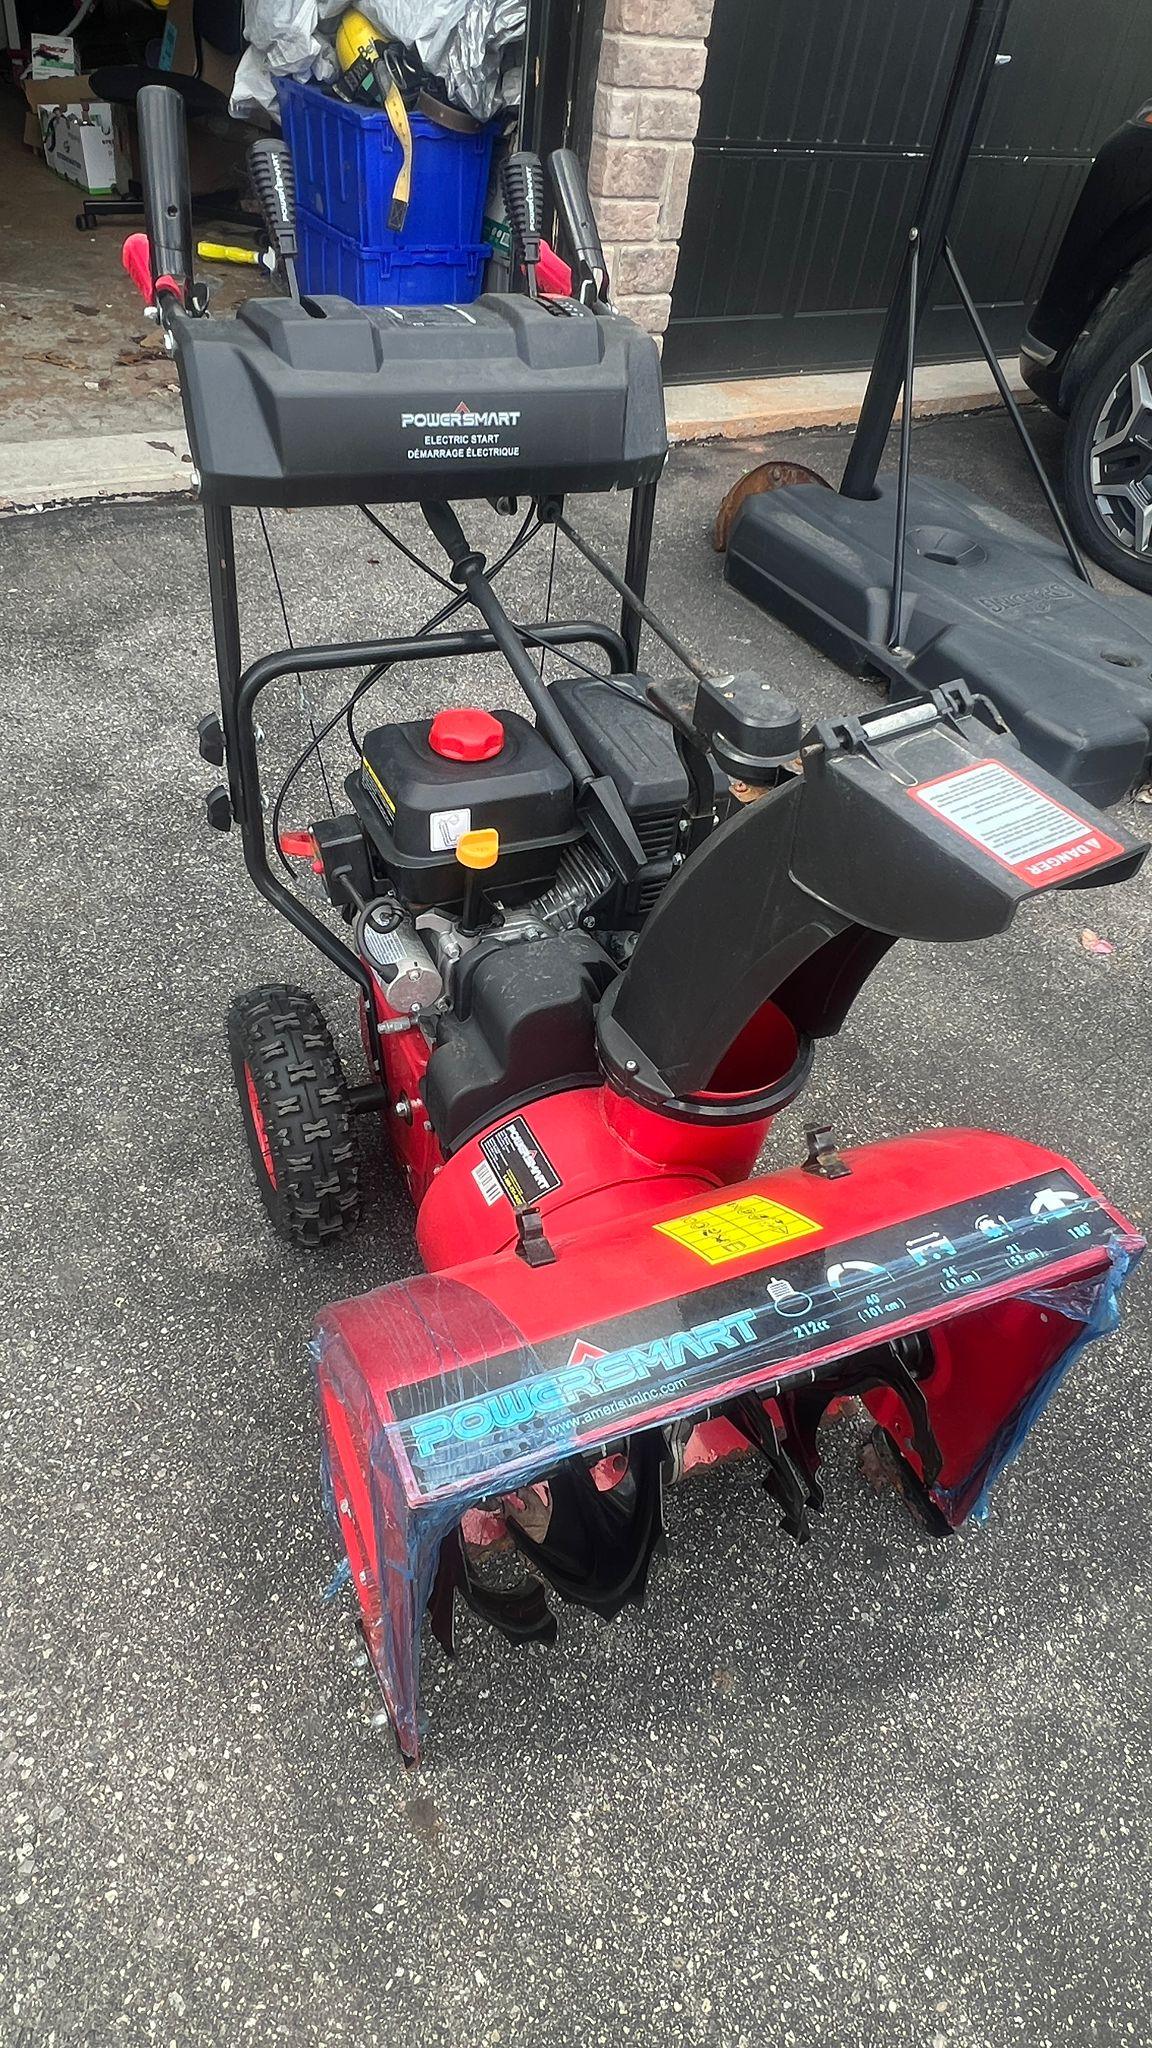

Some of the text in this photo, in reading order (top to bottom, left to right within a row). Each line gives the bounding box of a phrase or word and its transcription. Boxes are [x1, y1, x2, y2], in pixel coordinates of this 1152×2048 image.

[401, 412, 521, 428] POWERSMART
[424, 434, 500, 445] ELECTRIC START
[407, 447, 520, 459] DÉMARRAGE ÉLECTRIQUE
[1024, 844, 1092, 875] DANGER
[506, 1124, 551, 1190] POWERSMART
[793, 1319, 831, 1339] 212cc
[410, 1308, 757, 1458] POWERSMART
[547, 1378, 687, 1436] www.amerisuninc.com
